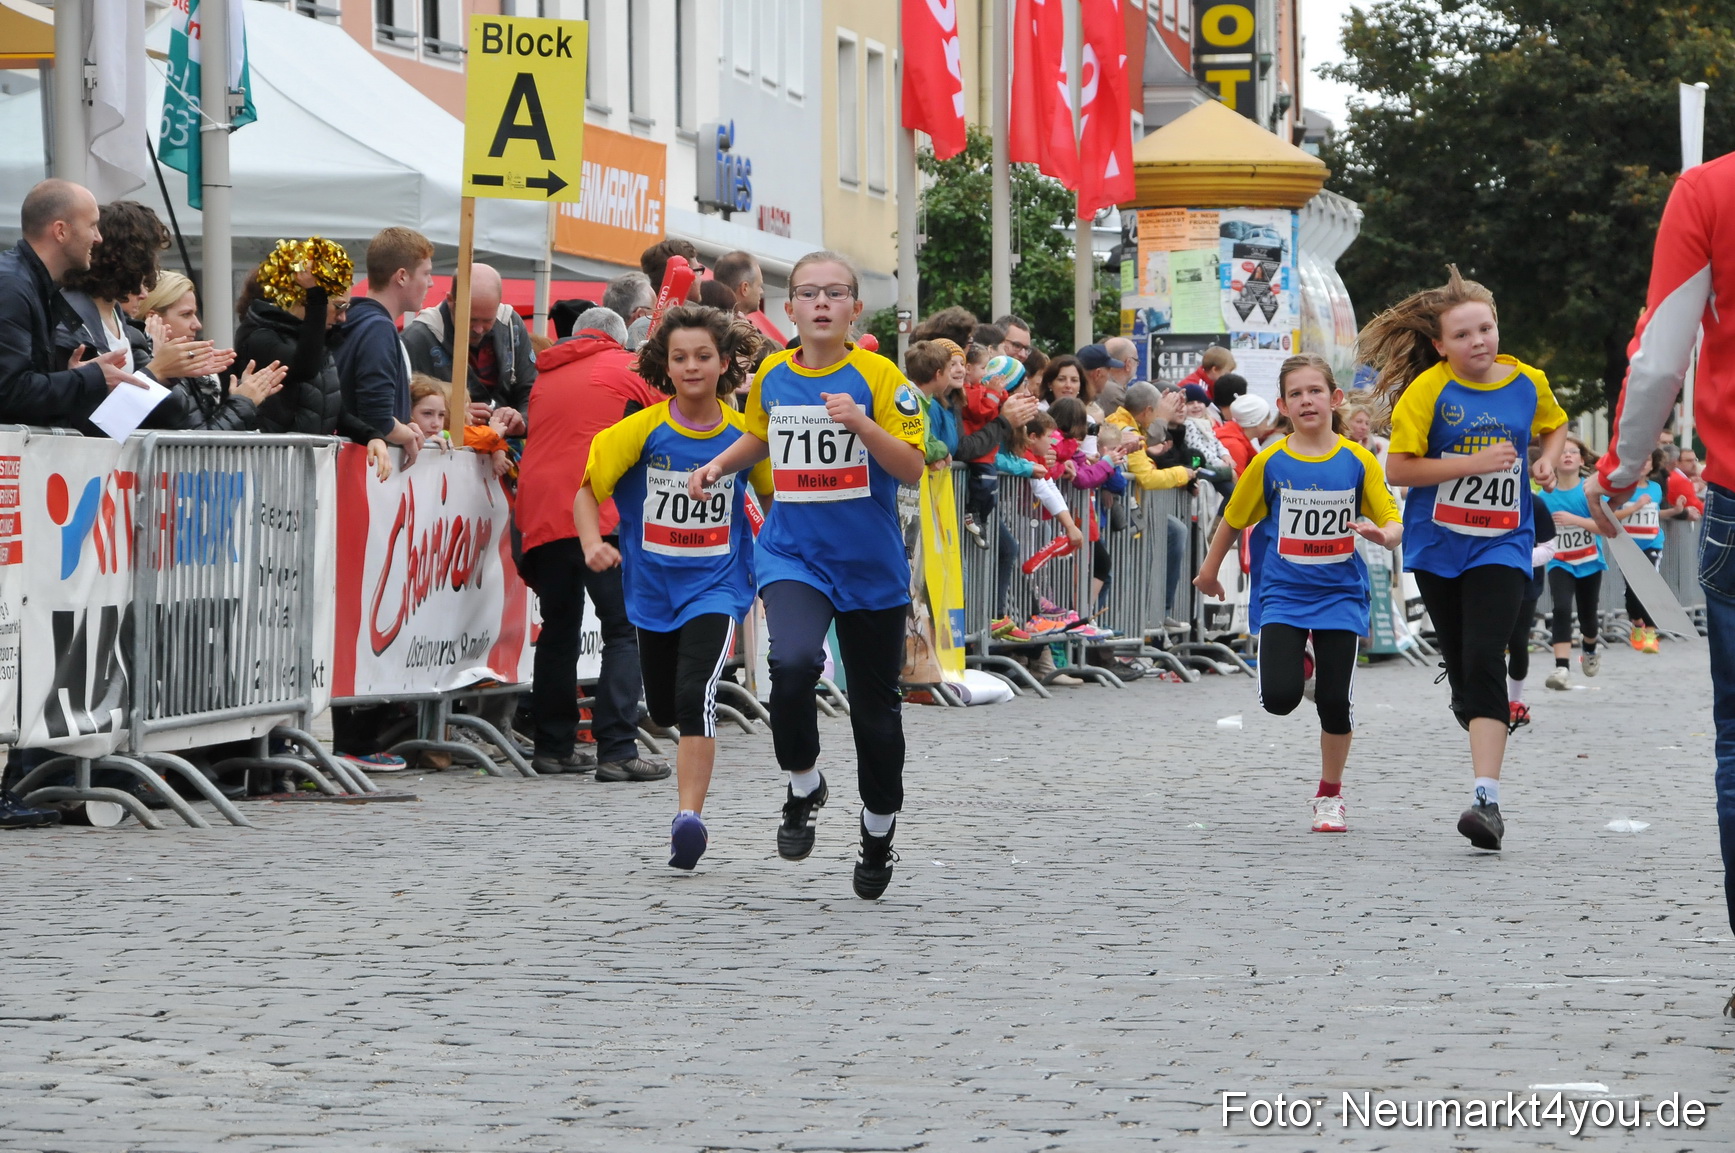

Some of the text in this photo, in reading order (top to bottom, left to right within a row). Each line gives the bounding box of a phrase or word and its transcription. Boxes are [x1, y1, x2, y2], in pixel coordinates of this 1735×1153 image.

[482, 22, 573, 58] Block
[487, 72, 556, 161] A
[770, 415, 800, 425] PARTL
[778, 429, 857, 465] 7167
[648, 476, 676, 488] PARTL
[797, 474, 837, 488] Meike
[1449, 475, 1515, 507] 7240
[655, 490, 726, 524] 7049
[1282, 495, 1347, 506] PARTL Neumarkt
[1287, 507, 1351, 536] 7020
[1464, 512, 1492, 527] Lucy
[669, 531, 705, 545] Stella
[1556, 529, 1593, 549] 7028
[1303, 543, 1334, 554] Maria
